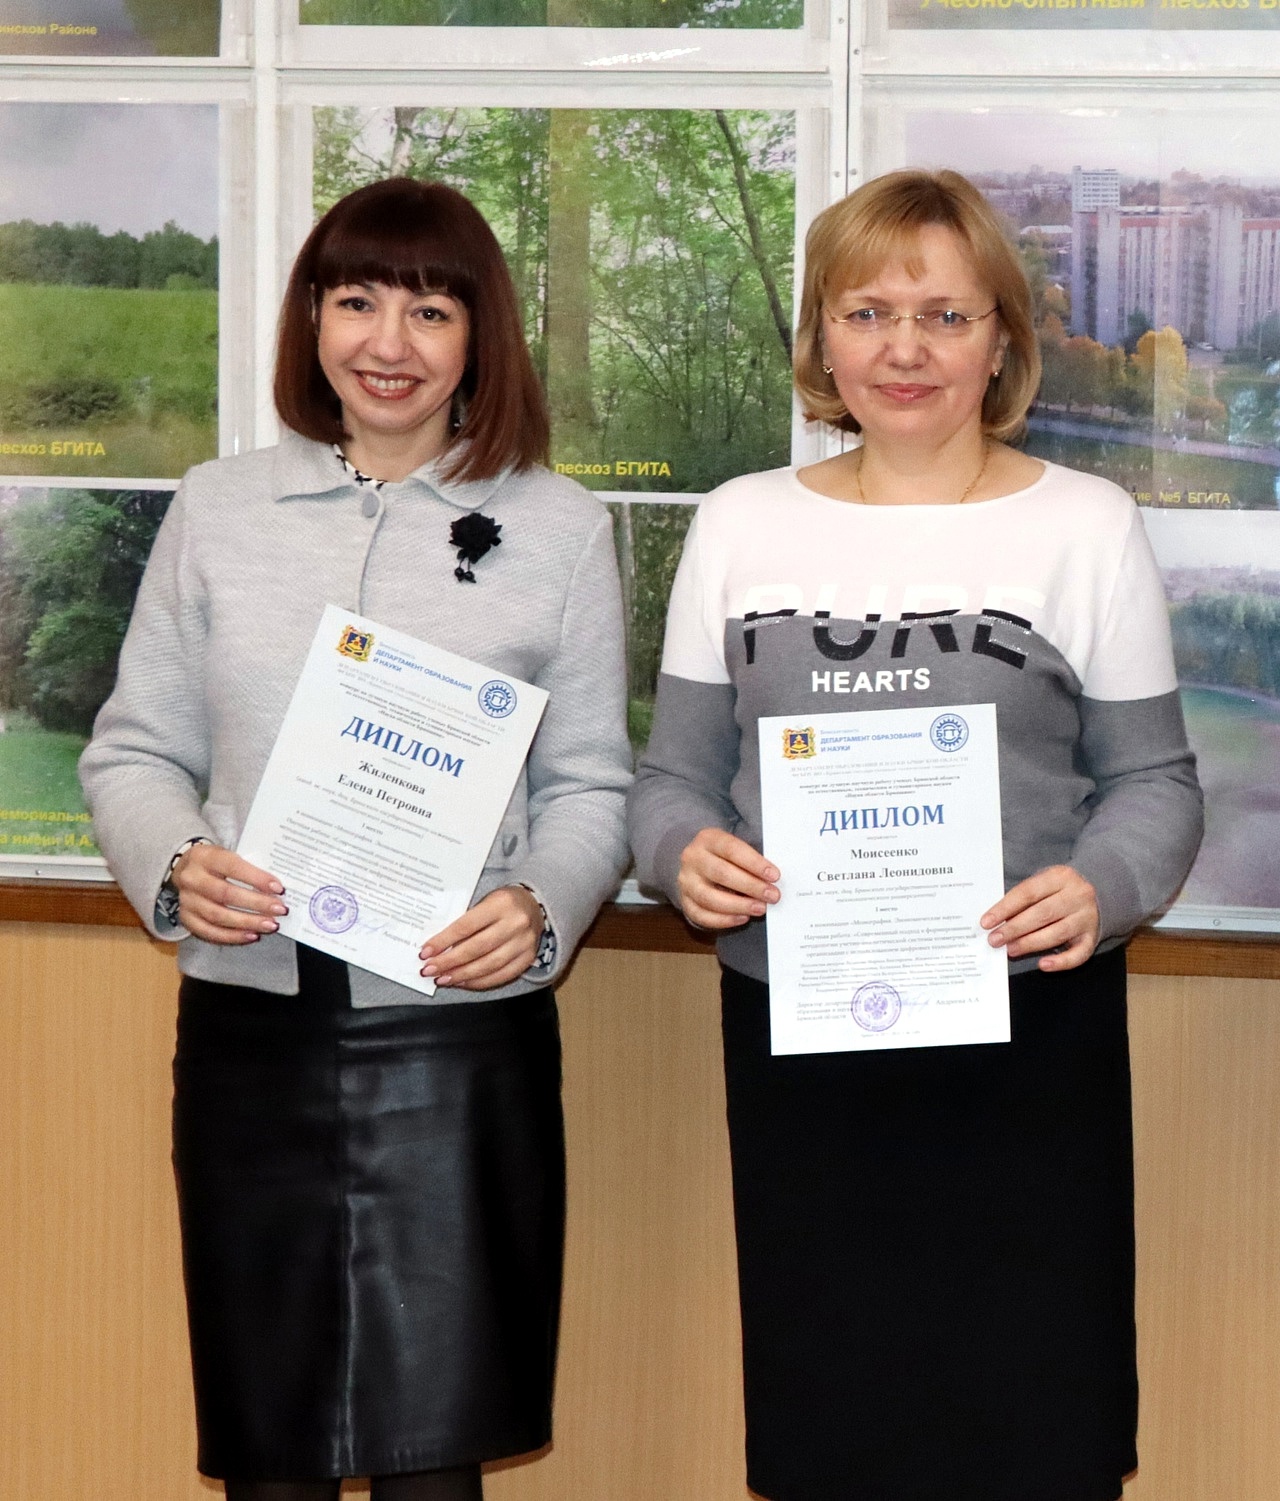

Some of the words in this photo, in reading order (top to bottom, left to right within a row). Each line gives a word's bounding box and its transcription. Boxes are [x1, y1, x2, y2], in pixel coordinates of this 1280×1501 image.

[50, 23, 97, 35] Районе
[0, 443, 46, 455] есхоз
[50, 441, 106, 456] БГИТА
[555, 462, 611, 475] лесхоз
[616, 461, 671, 476] БГИТА
[1159, 491, 1181, 503] №5
[1187, 491, 1231, 504] БГИТА
[743, 583, 1046, 670] PURE
[811, 668, 931, 693] HEARTS
[340, 716, 465, 777] ДИПЛОМ
[358, 760, 426, 795] Жиленкова
[337, 774, 374, 796] Елена
[376, 789, 433, 819] Петровна
[820, 804, 945, 836] ДИПЛОМ
[850, 848, 918, 860] Моисеенко
[817, 870, 876, 882] Светлана
[879, 865, 954, 878] Леонидовна
